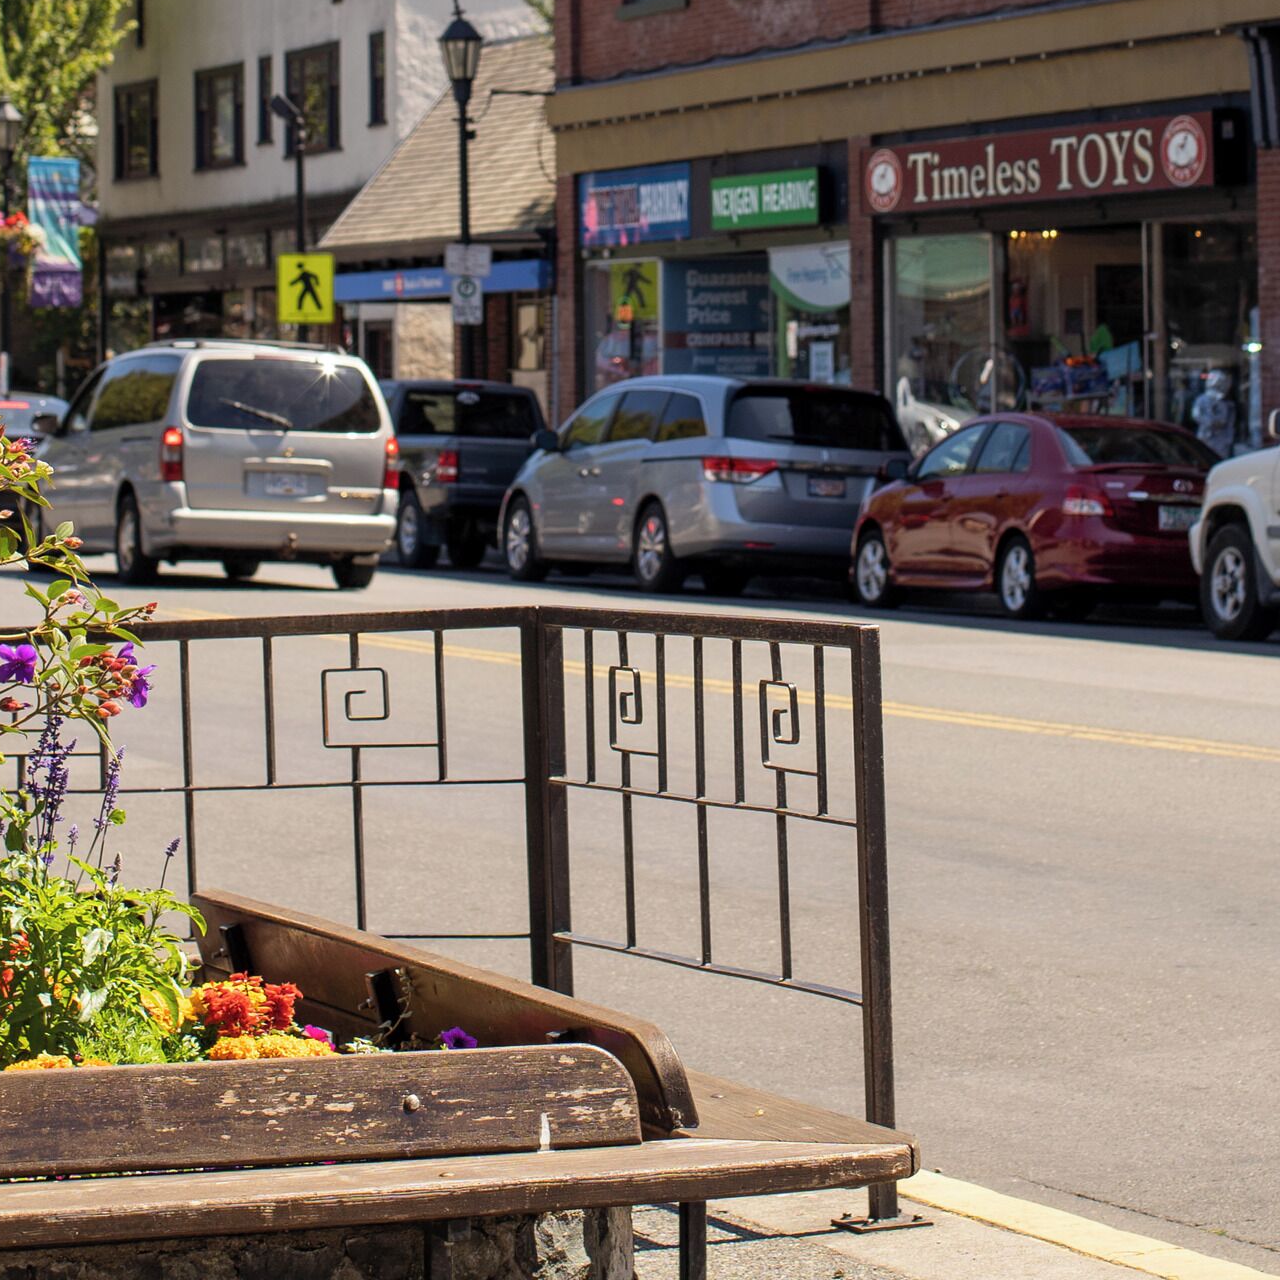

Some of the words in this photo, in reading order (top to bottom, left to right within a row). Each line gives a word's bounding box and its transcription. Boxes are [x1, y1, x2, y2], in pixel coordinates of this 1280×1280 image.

[907, 143, 1041, 204] Timeless
[1050, 127, 1155, 192] TOYS
[762, 179, 816, 213] HEARING
[686, 306, 732, 325] Price
